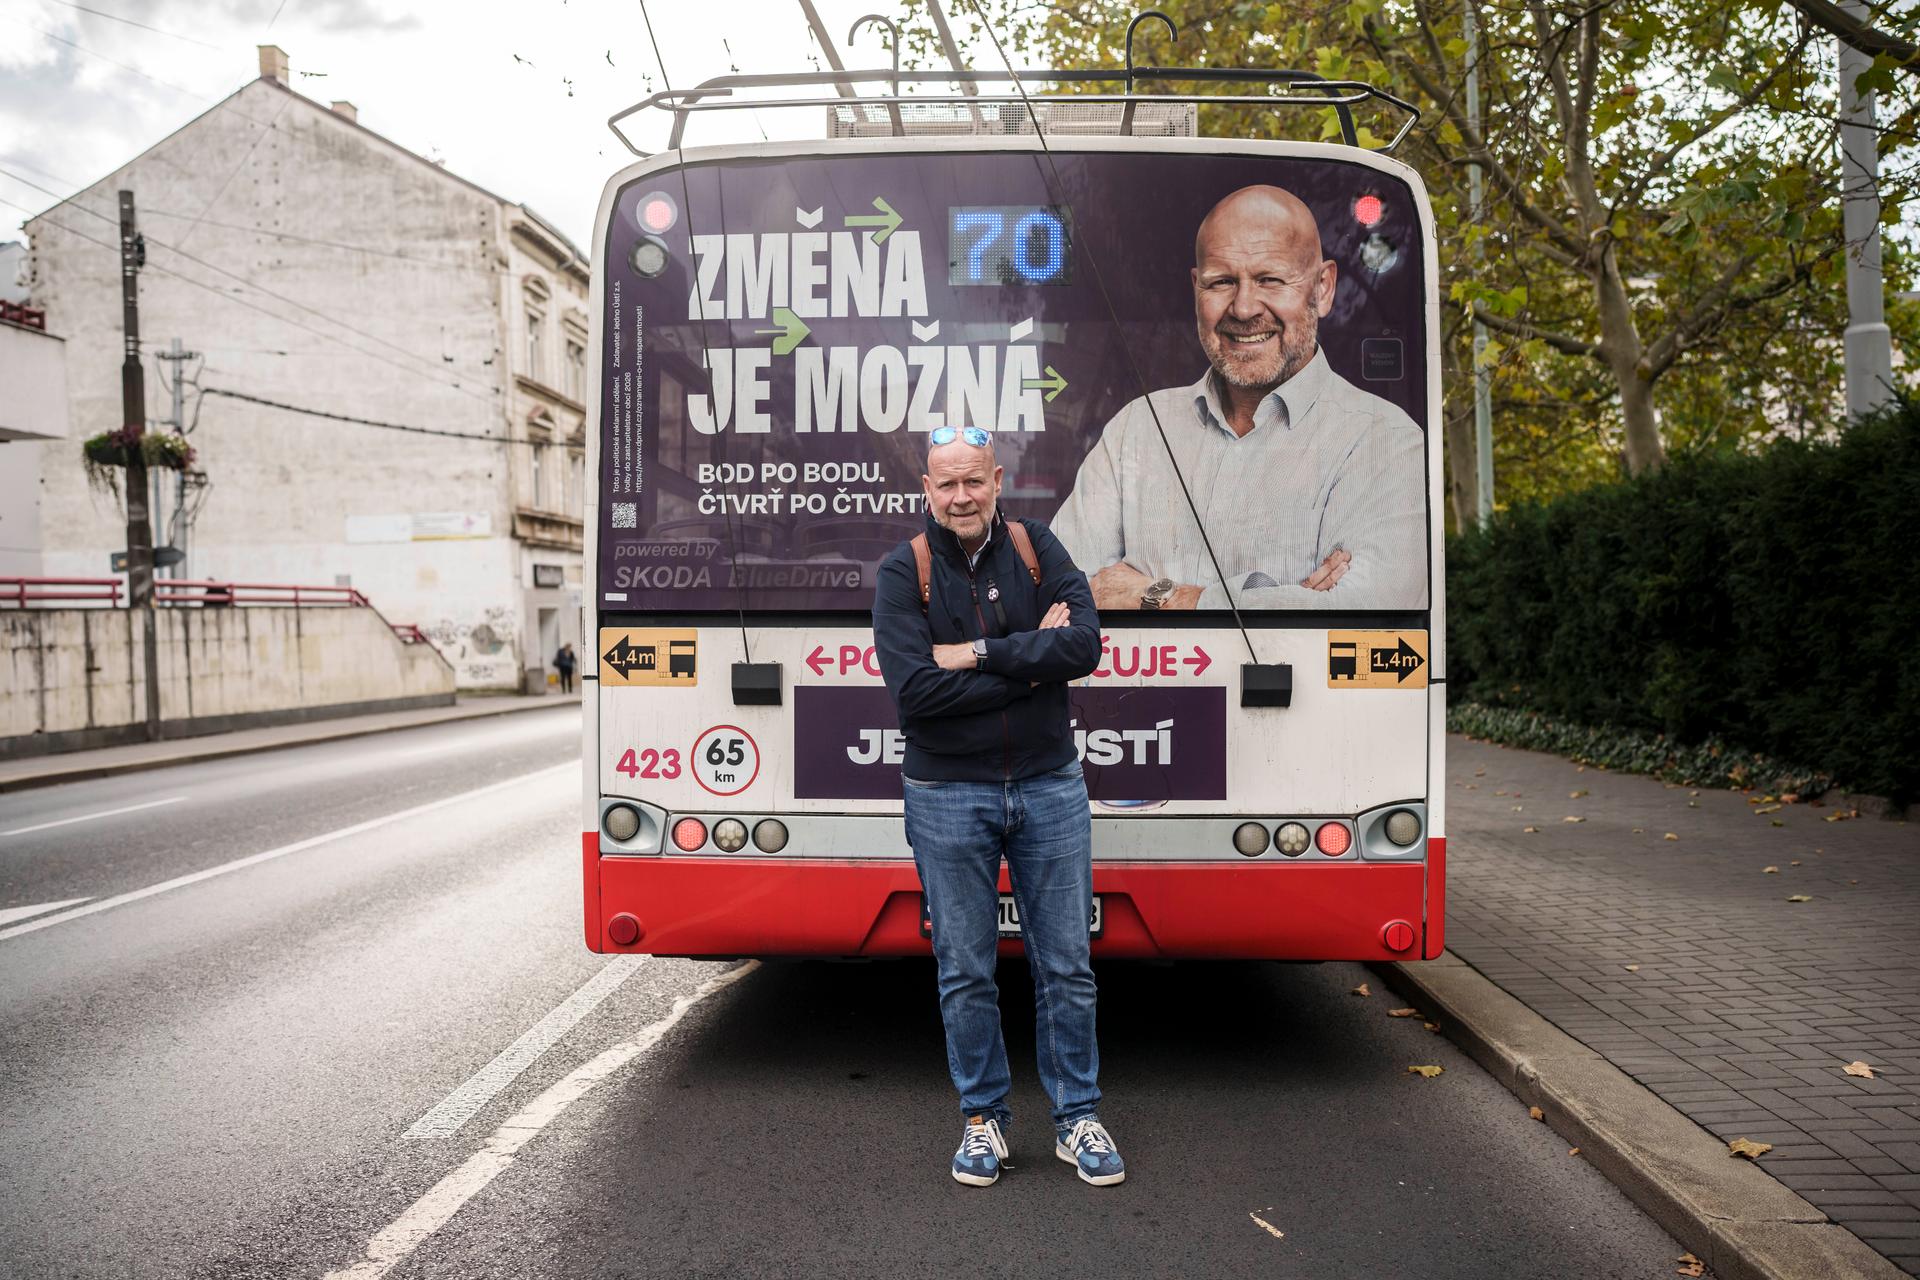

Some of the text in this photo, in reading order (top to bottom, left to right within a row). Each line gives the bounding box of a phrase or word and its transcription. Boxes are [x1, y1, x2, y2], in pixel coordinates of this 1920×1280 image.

[955, 213, 1062, 280] 70
[688, 206, 929, 320] ZMĚNA
[612, 293, 620, 308] Ústí
[687, 317, 1046, 434] JE MOŽNÁ
[624, 410, 632, 461] zastupitelstev
[613, 438, 621, 467] politické
[624, 463, 631, 472] do
[698, 462, 886, 484] BOD PO BODU.
[624, 473, 632, 493] Volby
[697, 488, 784, 514] ČTVRŤ
[790, 494, 827, 514] PO
[614, 541, 717, 560] powered by
[614, 566, 861, 588] SKODA BlueDrive
[706, 738, 745, 766] 65
[846, 729, 906, 765] JE
[616, 748, 682, 780] 423
[714, 770, 735, 783] km
